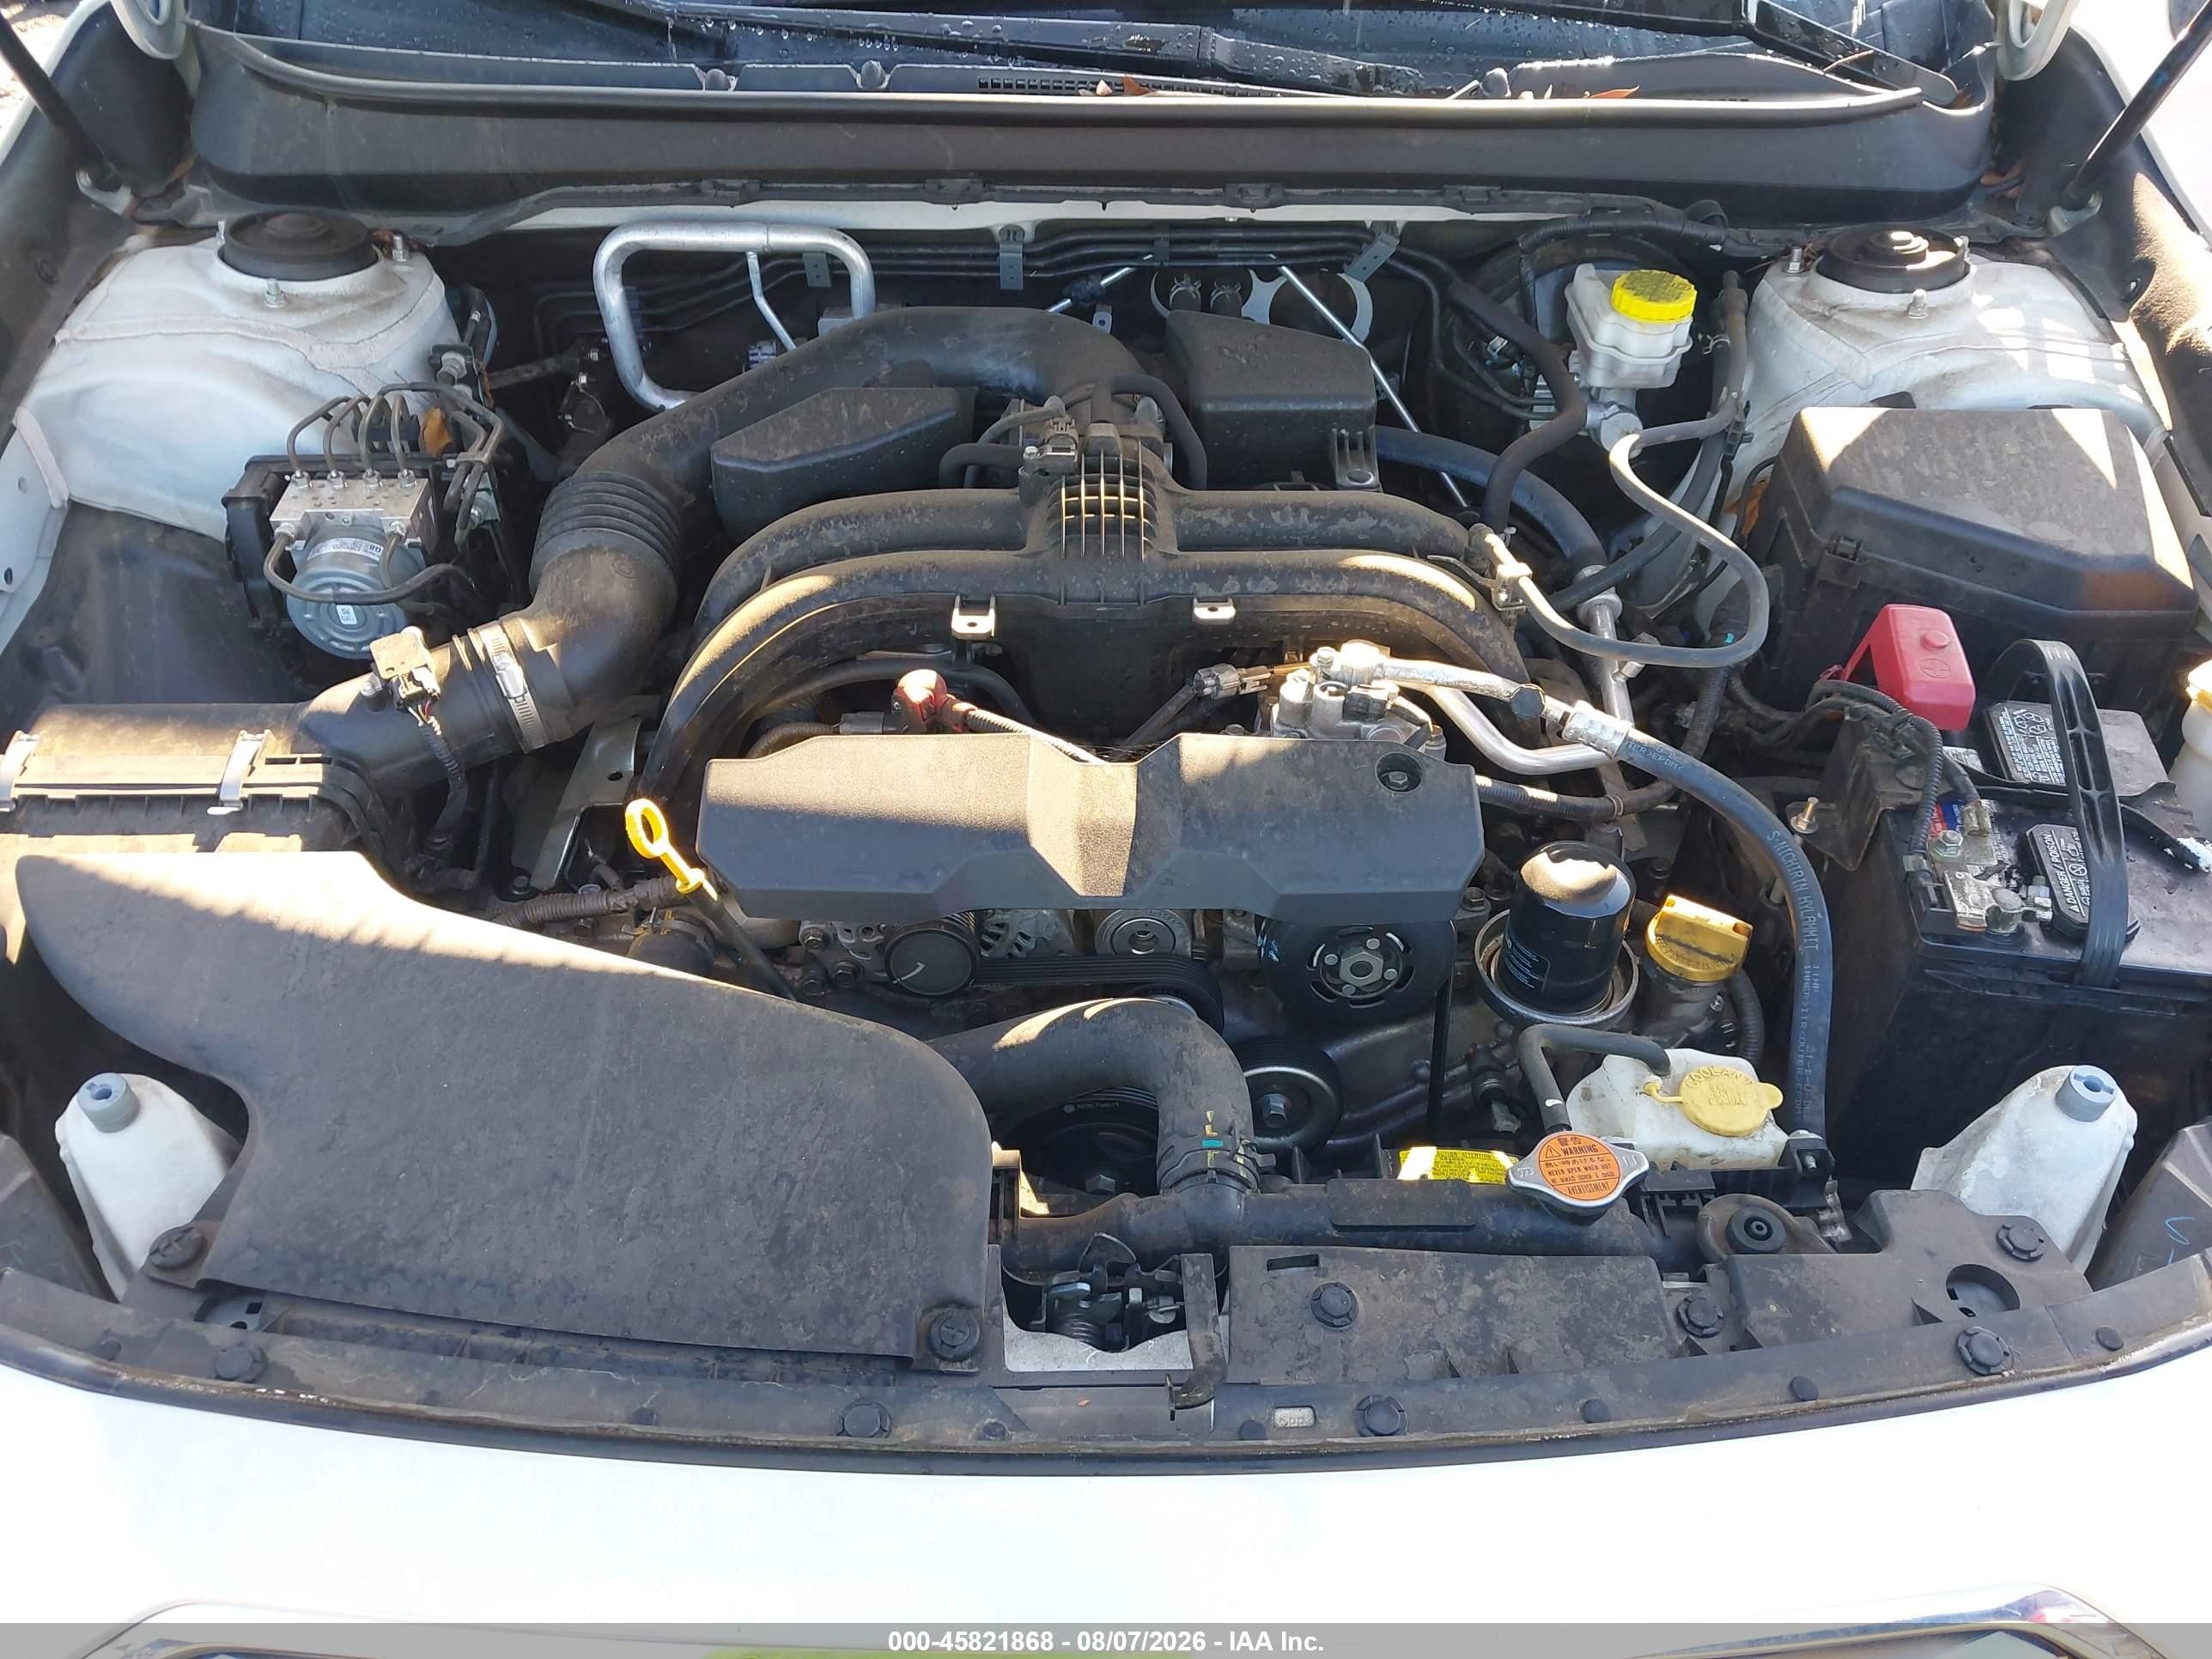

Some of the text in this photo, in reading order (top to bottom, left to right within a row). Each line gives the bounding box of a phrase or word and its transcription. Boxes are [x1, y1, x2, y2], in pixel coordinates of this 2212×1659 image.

[2042, 834, 2061, 863] POISON
[2057, 871, 2075, 904] DANGER
[1686, 1066, 1753, 1088] COOLANT
[1557, 1136, 1583, 1146] 警告
[1560, 1144, 1599, 1157] WARNING
[1548, 1168, 1565, 1176] NEVER
[1601, 1162, 1612, 1170] HOT
[1566, 1182, 1611, 1196] AVERTISSMENT
